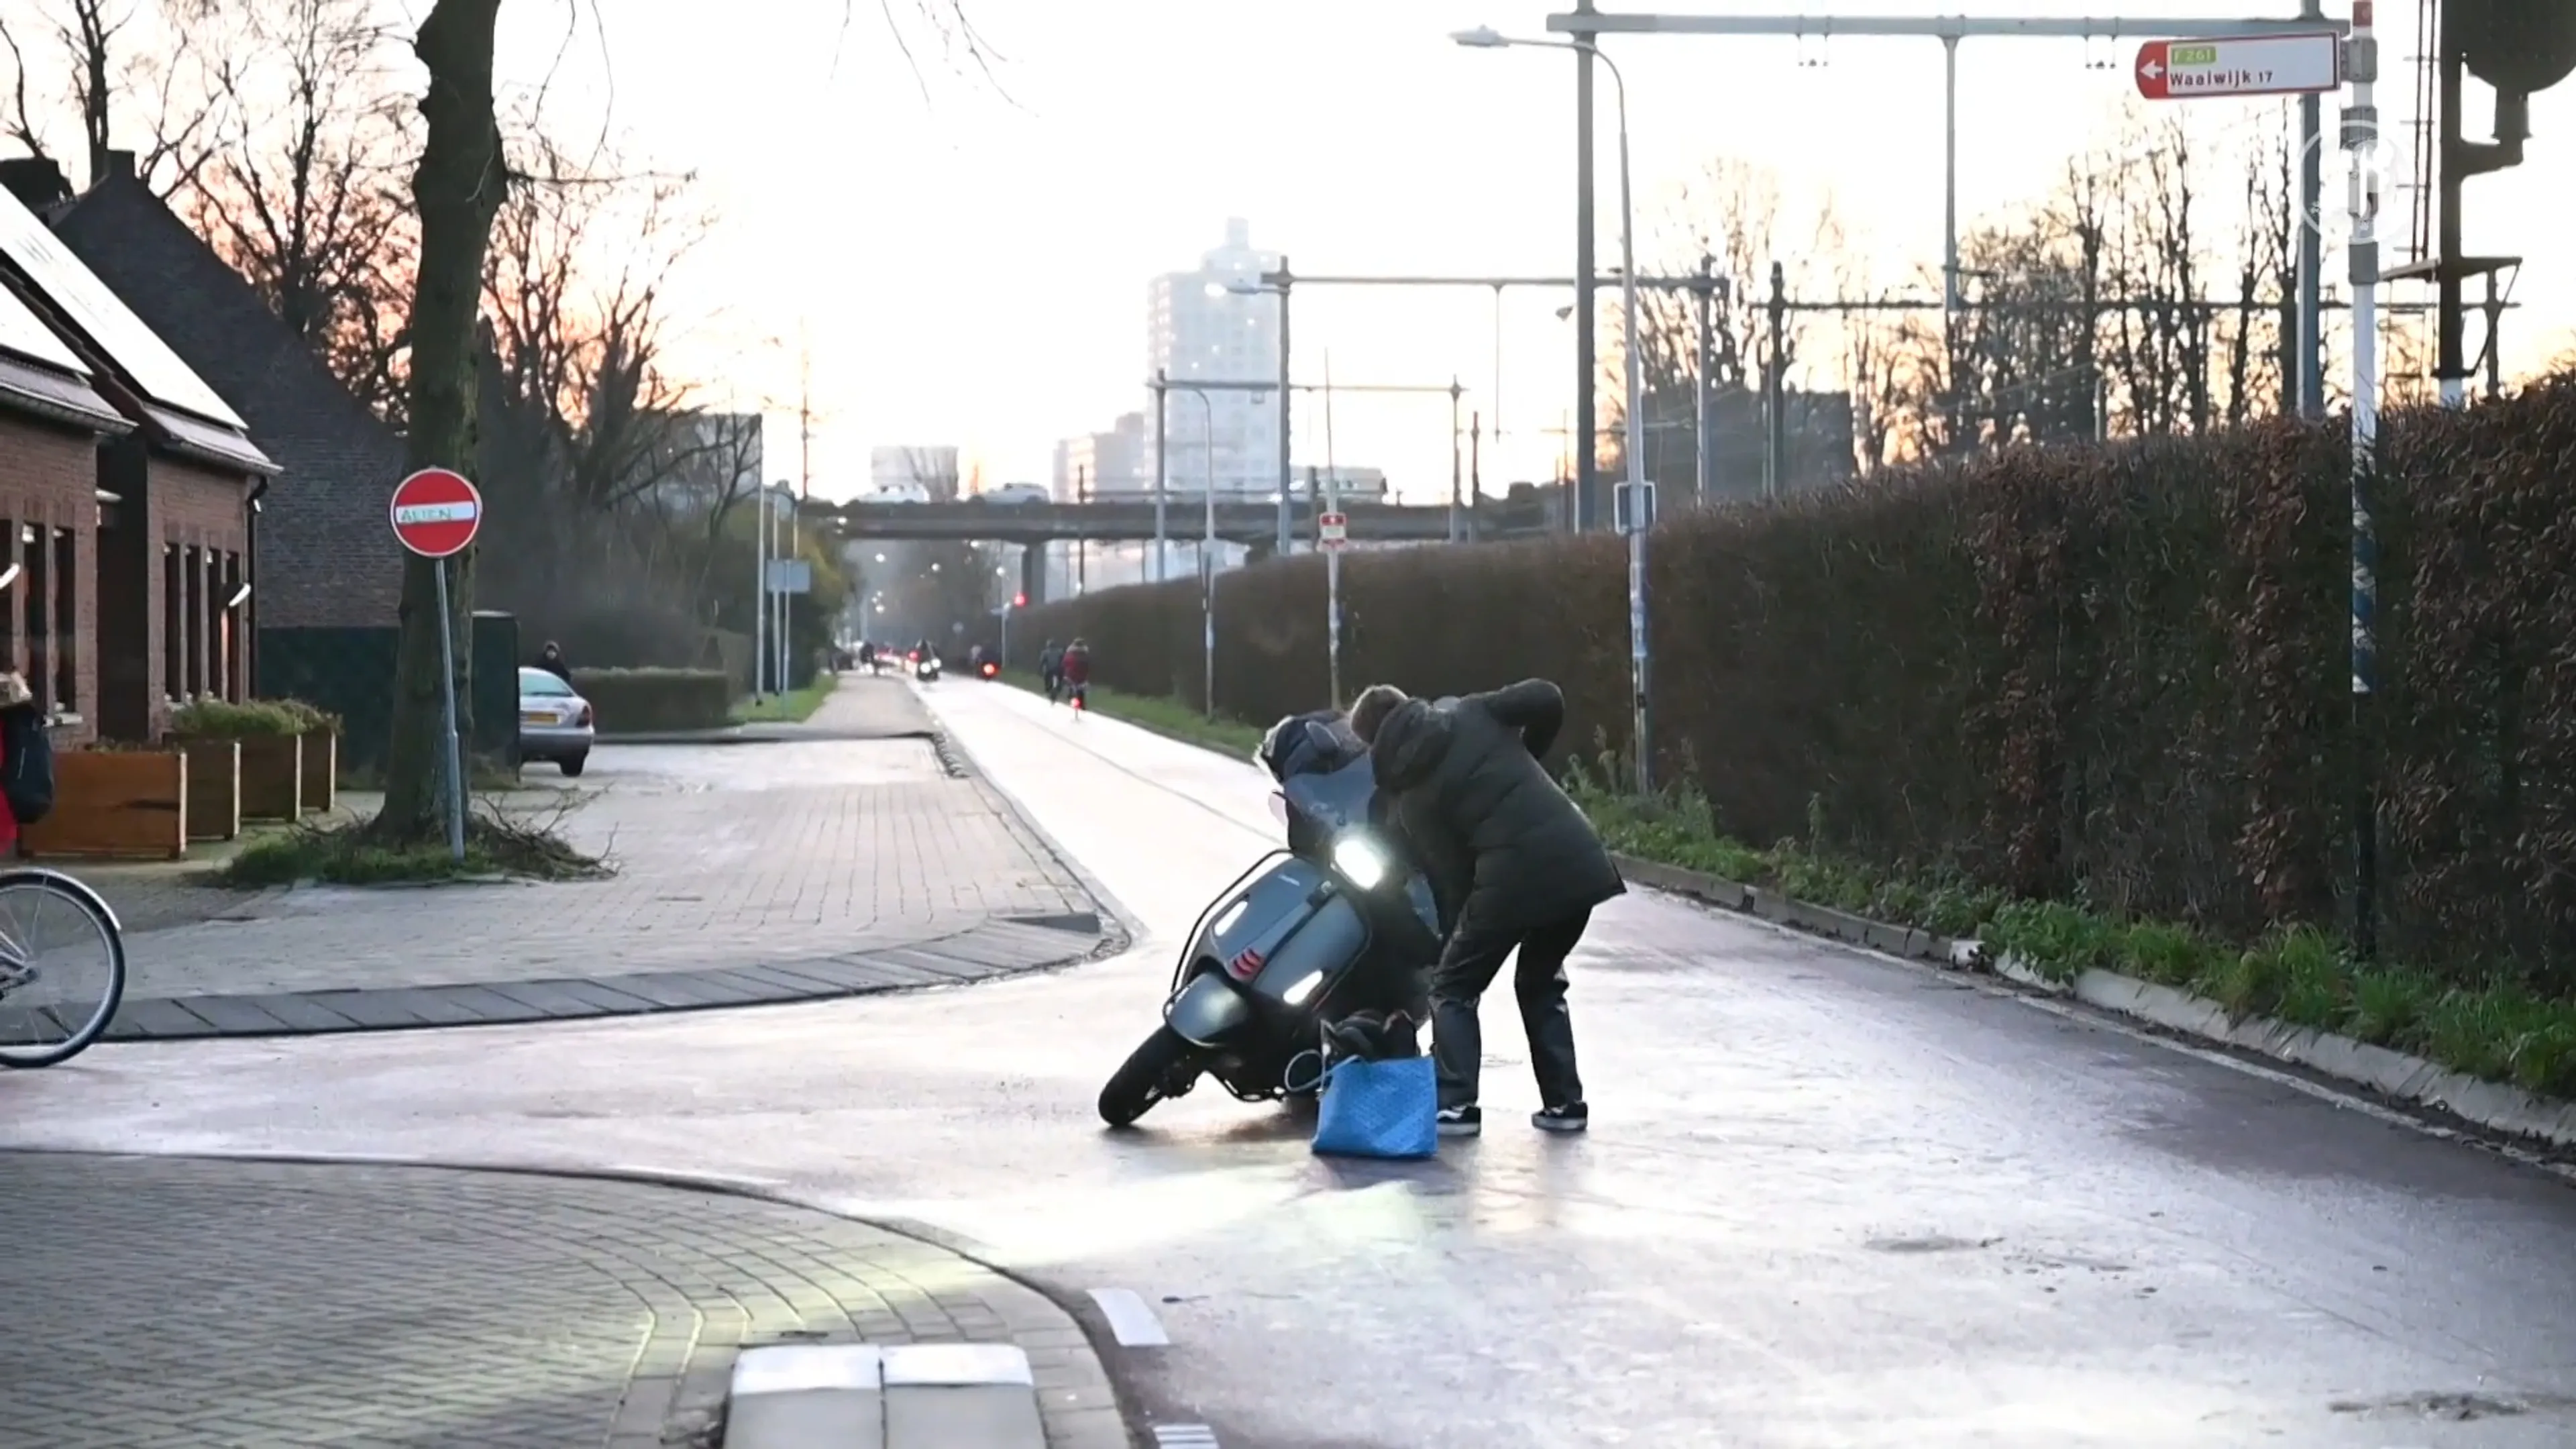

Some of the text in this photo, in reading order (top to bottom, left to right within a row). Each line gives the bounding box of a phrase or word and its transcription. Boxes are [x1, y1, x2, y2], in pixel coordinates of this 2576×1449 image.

[2186, 49, 2211, 61] 261
[2170, 70, 2273, 88] Waalwijk 17
